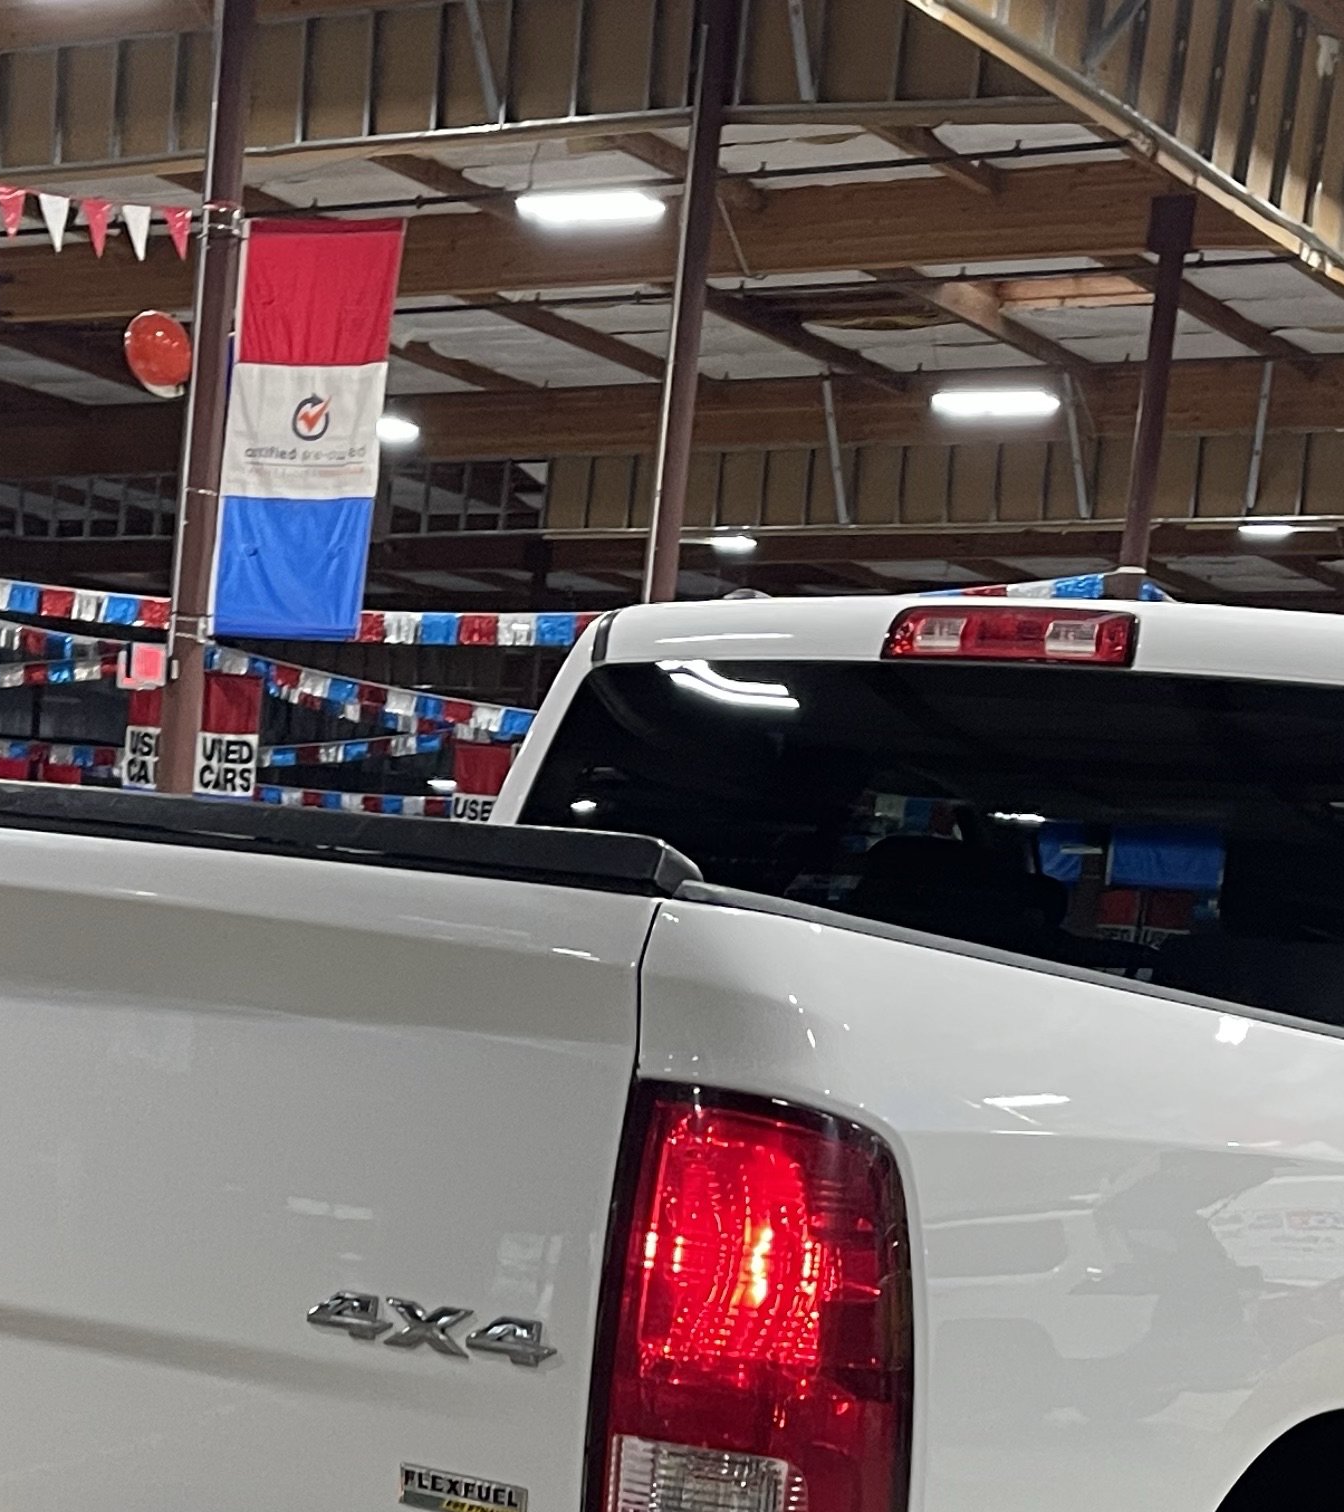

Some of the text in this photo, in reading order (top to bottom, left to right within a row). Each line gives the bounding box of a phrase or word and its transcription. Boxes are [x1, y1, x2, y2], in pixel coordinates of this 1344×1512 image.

[130, 730, 159, 757] US
[127, 758, 151, 784] CA
[453, 797, 494, 821] USE
[403, 1469, 518, 1508] FLEXFUEL
